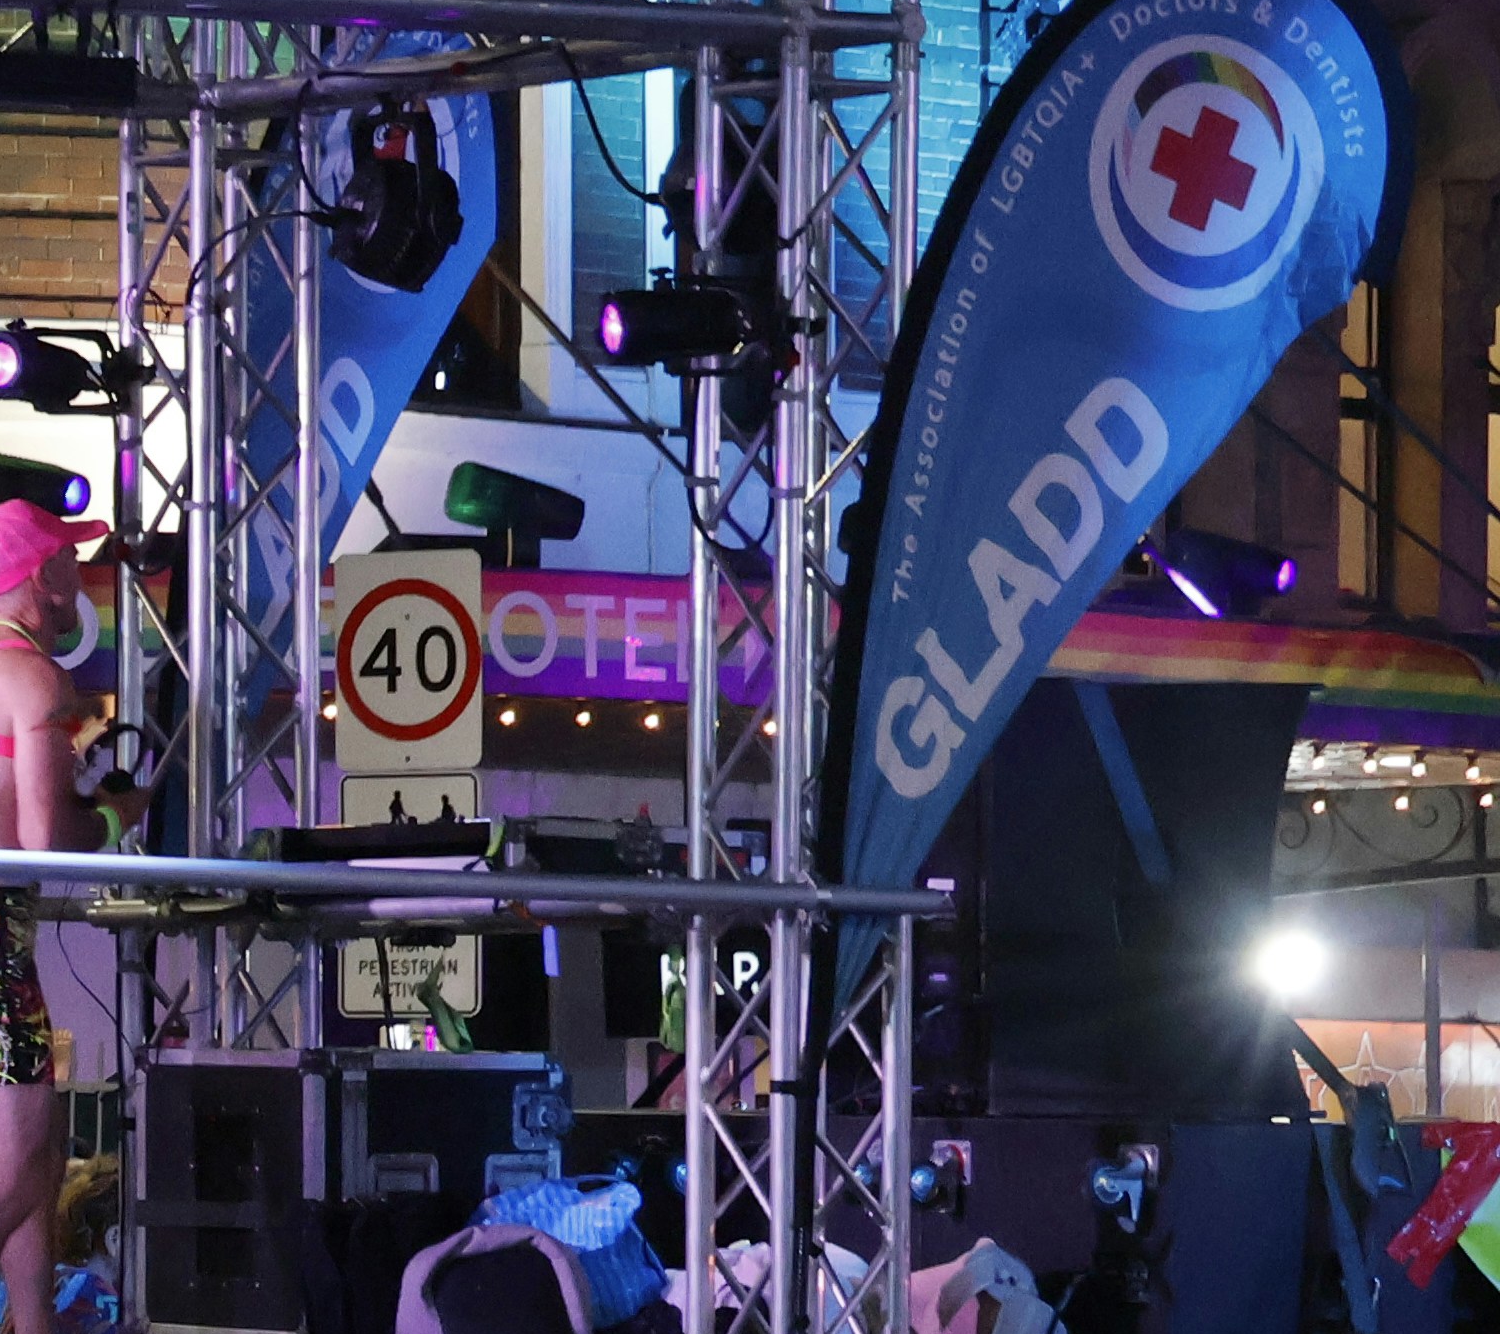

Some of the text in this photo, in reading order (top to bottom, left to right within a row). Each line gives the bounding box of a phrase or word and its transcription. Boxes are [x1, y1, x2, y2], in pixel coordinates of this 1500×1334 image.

[989, 49, 1100, 216] LGBTQIA+
[1283, 16, 1367, 160] Dentists
[970, 227, 996, 275] of
[904, 288, 977, 518] Association
[875, 376, 1170, 799] GLADD
[891, 532, 919, 605] The
[359, 625, 458, 694] 40
